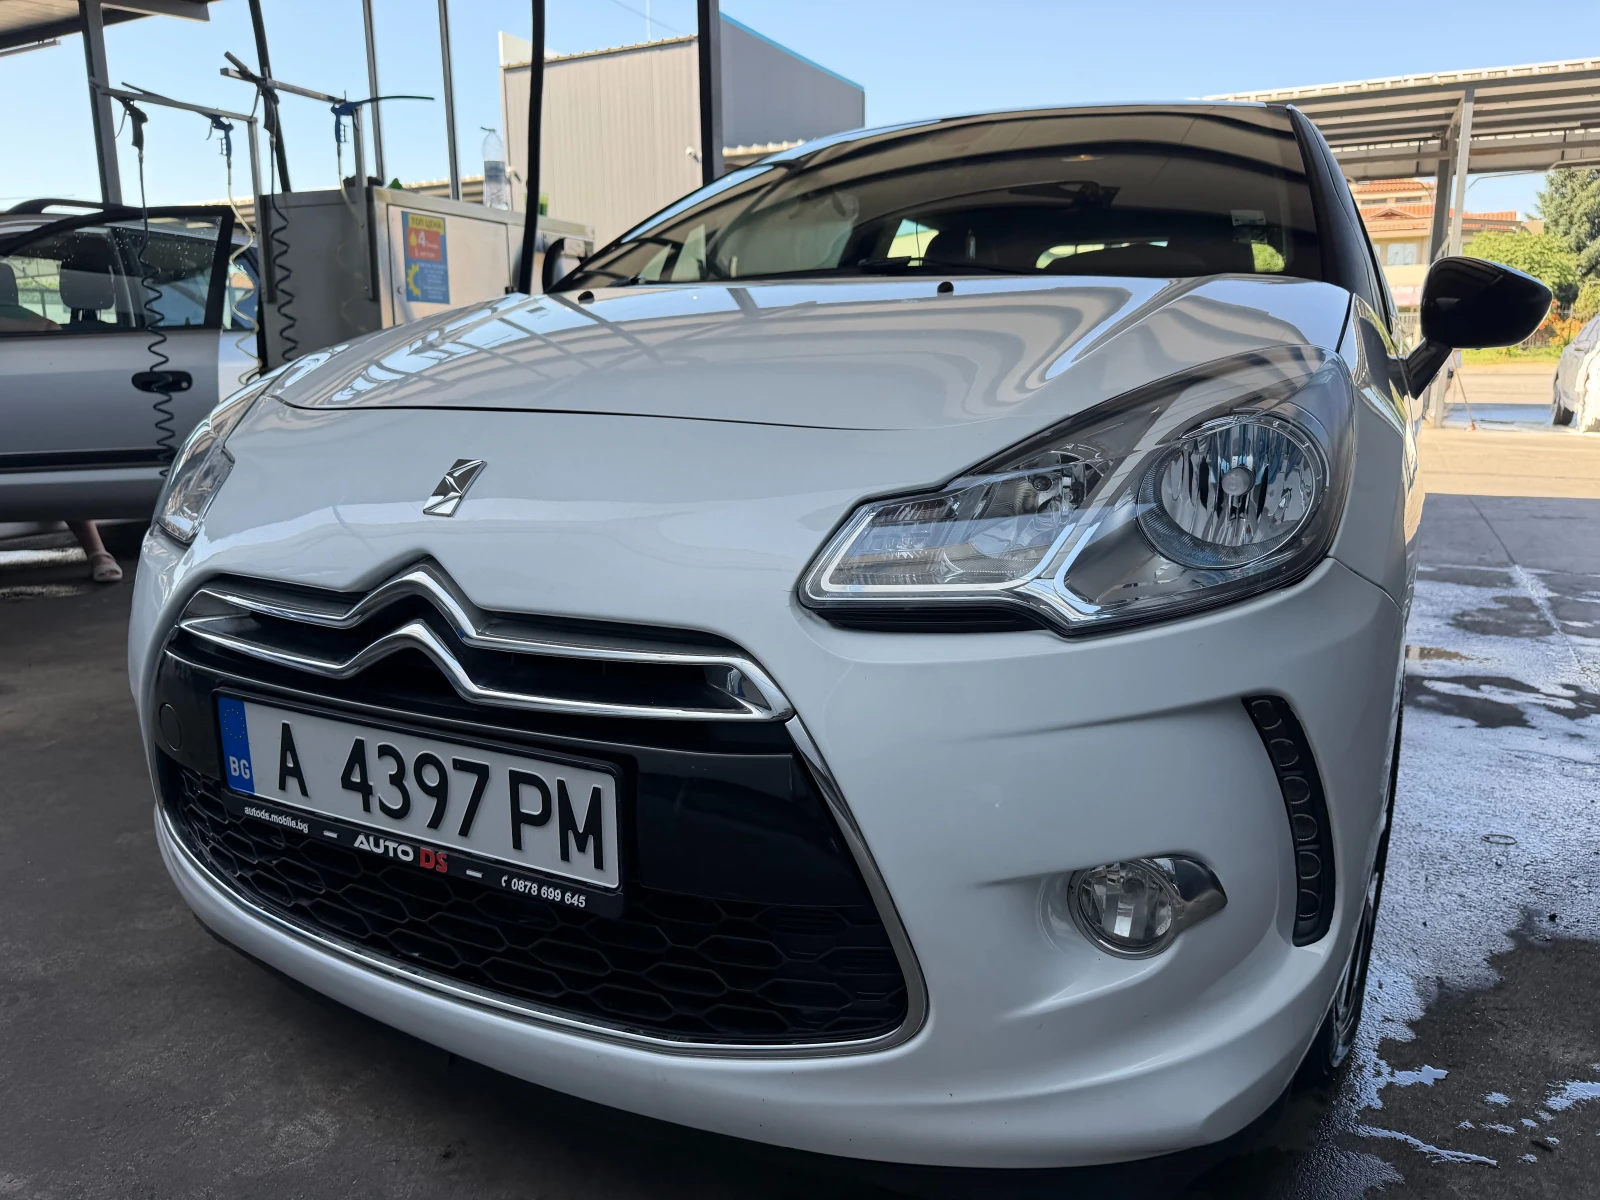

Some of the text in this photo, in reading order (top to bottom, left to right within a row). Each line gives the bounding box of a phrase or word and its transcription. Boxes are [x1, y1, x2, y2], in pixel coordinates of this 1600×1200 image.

[418, 231, 426, 247] 4
[229, 755, 251, 780] BG
[278, 720, 604, 870] A 4397 PM
[244, 806, 308, 833] autods.mobile.bg
[353, 834, 448, 873] AUTO DS
[511, 878, 586, 908] 0878 699 645
